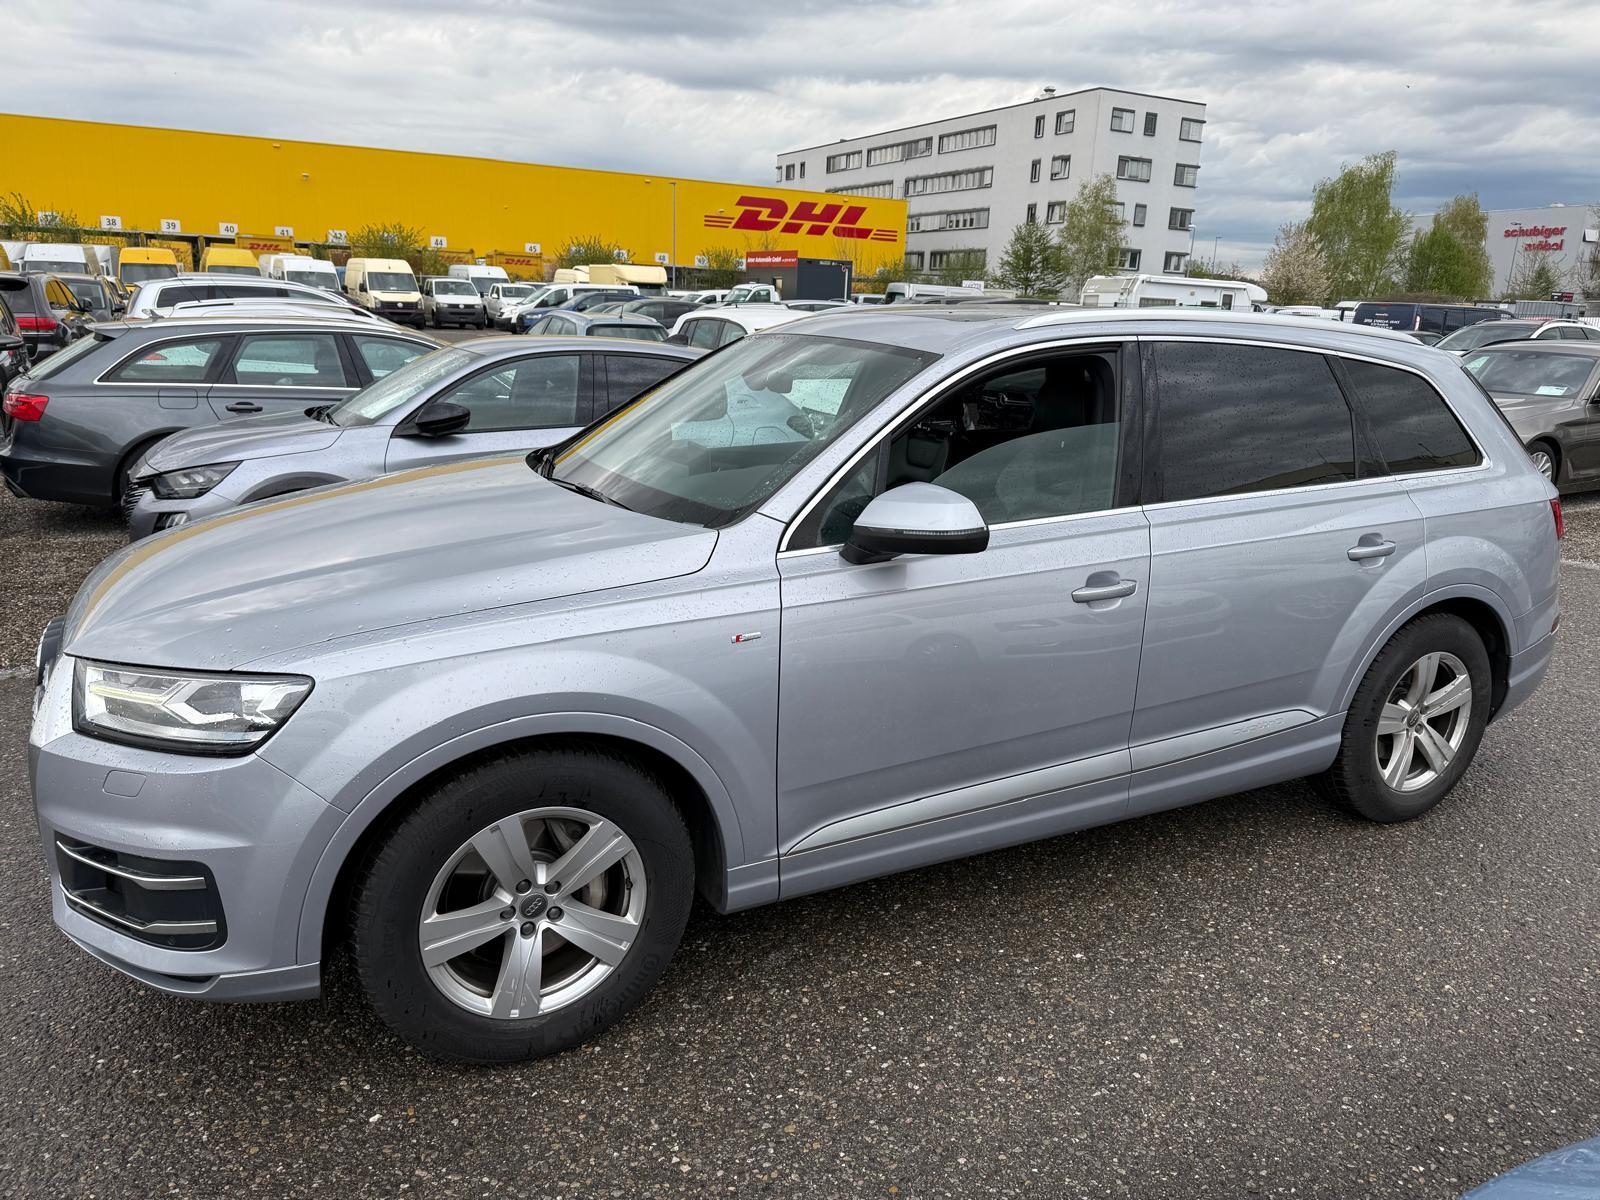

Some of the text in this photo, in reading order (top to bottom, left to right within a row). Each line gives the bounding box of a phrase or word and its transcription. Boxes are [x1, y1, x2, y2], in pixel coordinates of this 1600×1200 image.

[106, 217, 117, 227] 38
[732, 196, 874, 239] DHL
[165, 220, 176, 230] 39
[224, 224, 235, 234] 40
[1503, 225, 1567, 238] schubiger
[247, 242, 283, 251] DHL
[434, 238, 444, 247] 44
[528, 244, 538, 253] 45
[504, 257, 535, 266] DHL
[657, 253, 667, 262] 48
